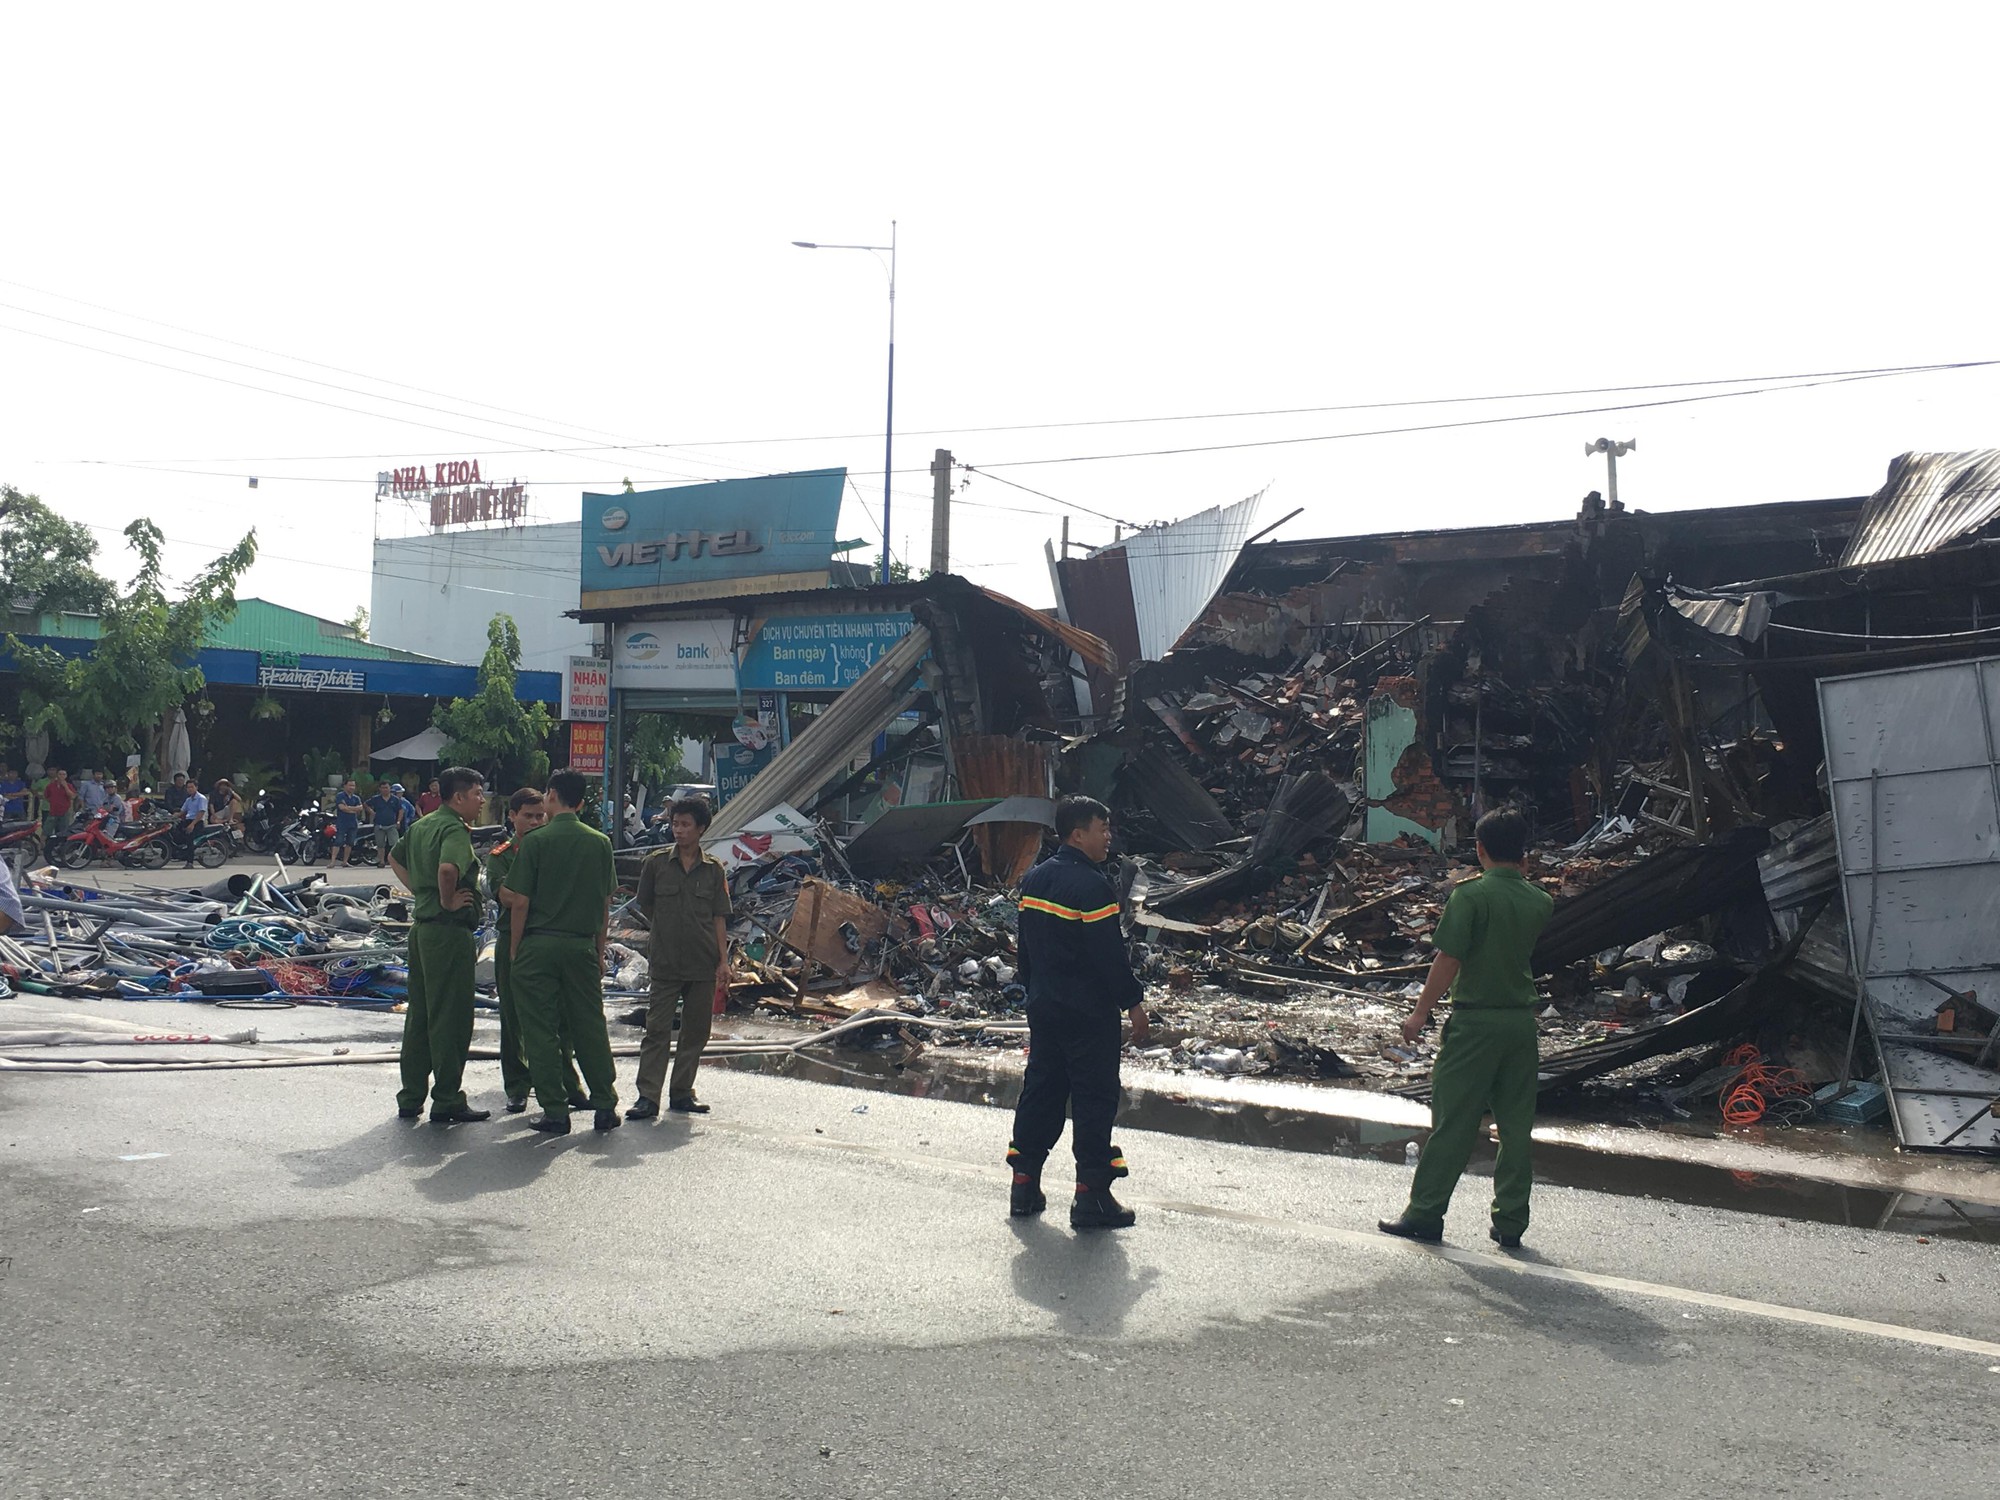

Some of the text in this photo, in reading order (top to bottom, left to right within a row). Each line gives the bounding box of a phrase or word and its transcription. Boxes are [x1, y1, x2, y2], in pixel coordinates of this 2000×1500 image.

[393, 459, 481, 492] NHA KHOA
[763, 626, 780, 643] DỊCH
[783, 625, 792, 642] VỤ
[845, 623, 874, 637] NHANH
[875, 619, 897, 636] TRÊN
[677, 643, 709, 658] bank
[774, 644, 826, 662] Ban ngày
[840, 644, 865, 661] không
[574, 670, 606, 687] NHẬN
[775, 671, 825, 685] Ban đêm
[844, 666, 860, 682] quá
[762, 700, 773, 708] 327
[574, 744, 584, 754] XE
